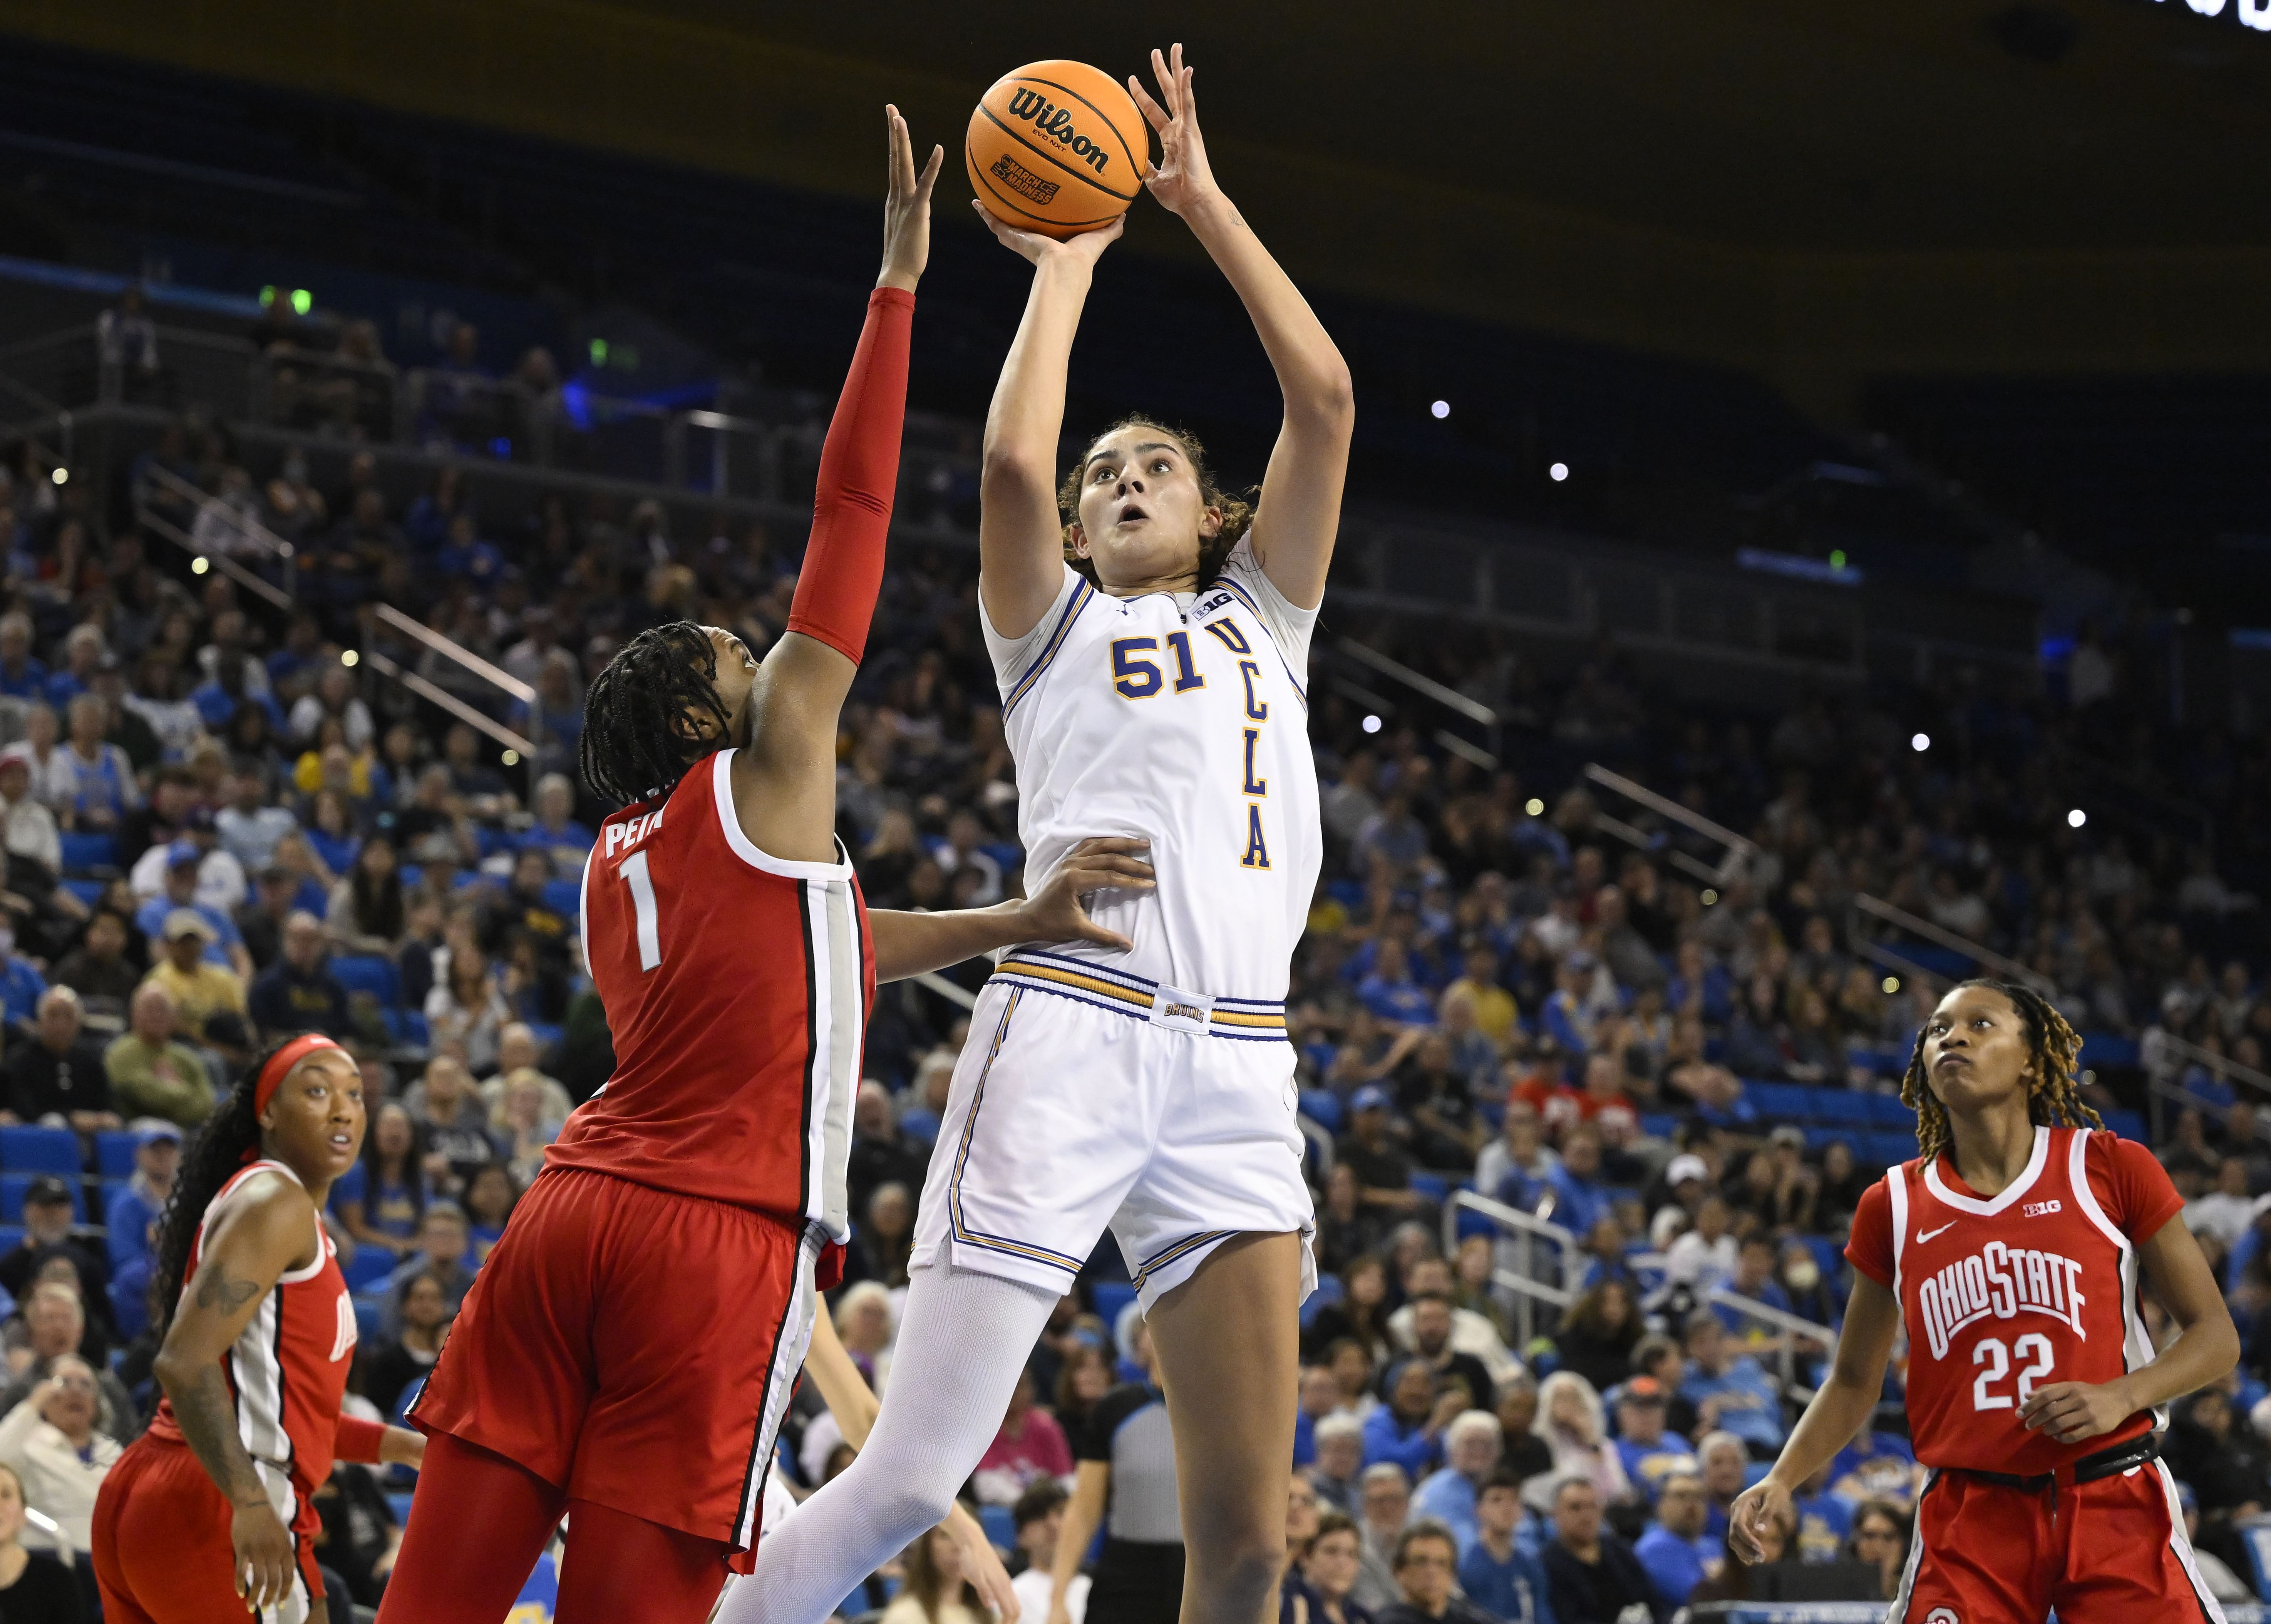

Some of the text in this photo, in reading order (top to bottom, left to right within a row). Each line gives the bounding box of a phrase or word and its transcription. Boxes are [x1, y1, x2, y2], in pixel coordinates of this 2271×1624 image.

[1008, 87, 1109, 174] Wilson
[1032, 129, 1066, 152] EVO NXT
[1007, 162, 1042, 188] MARCH
[1007, 174, 1052, 203] MADNESS
[1110, 630, 1207, 700] 51
[1204, 616, 1271, 871] UCLA
[618, 849, 662, 973] 1
[1164, 1003, 1204, 1023] BRUINS
[1973, 1333, 2055, 1411] 22
